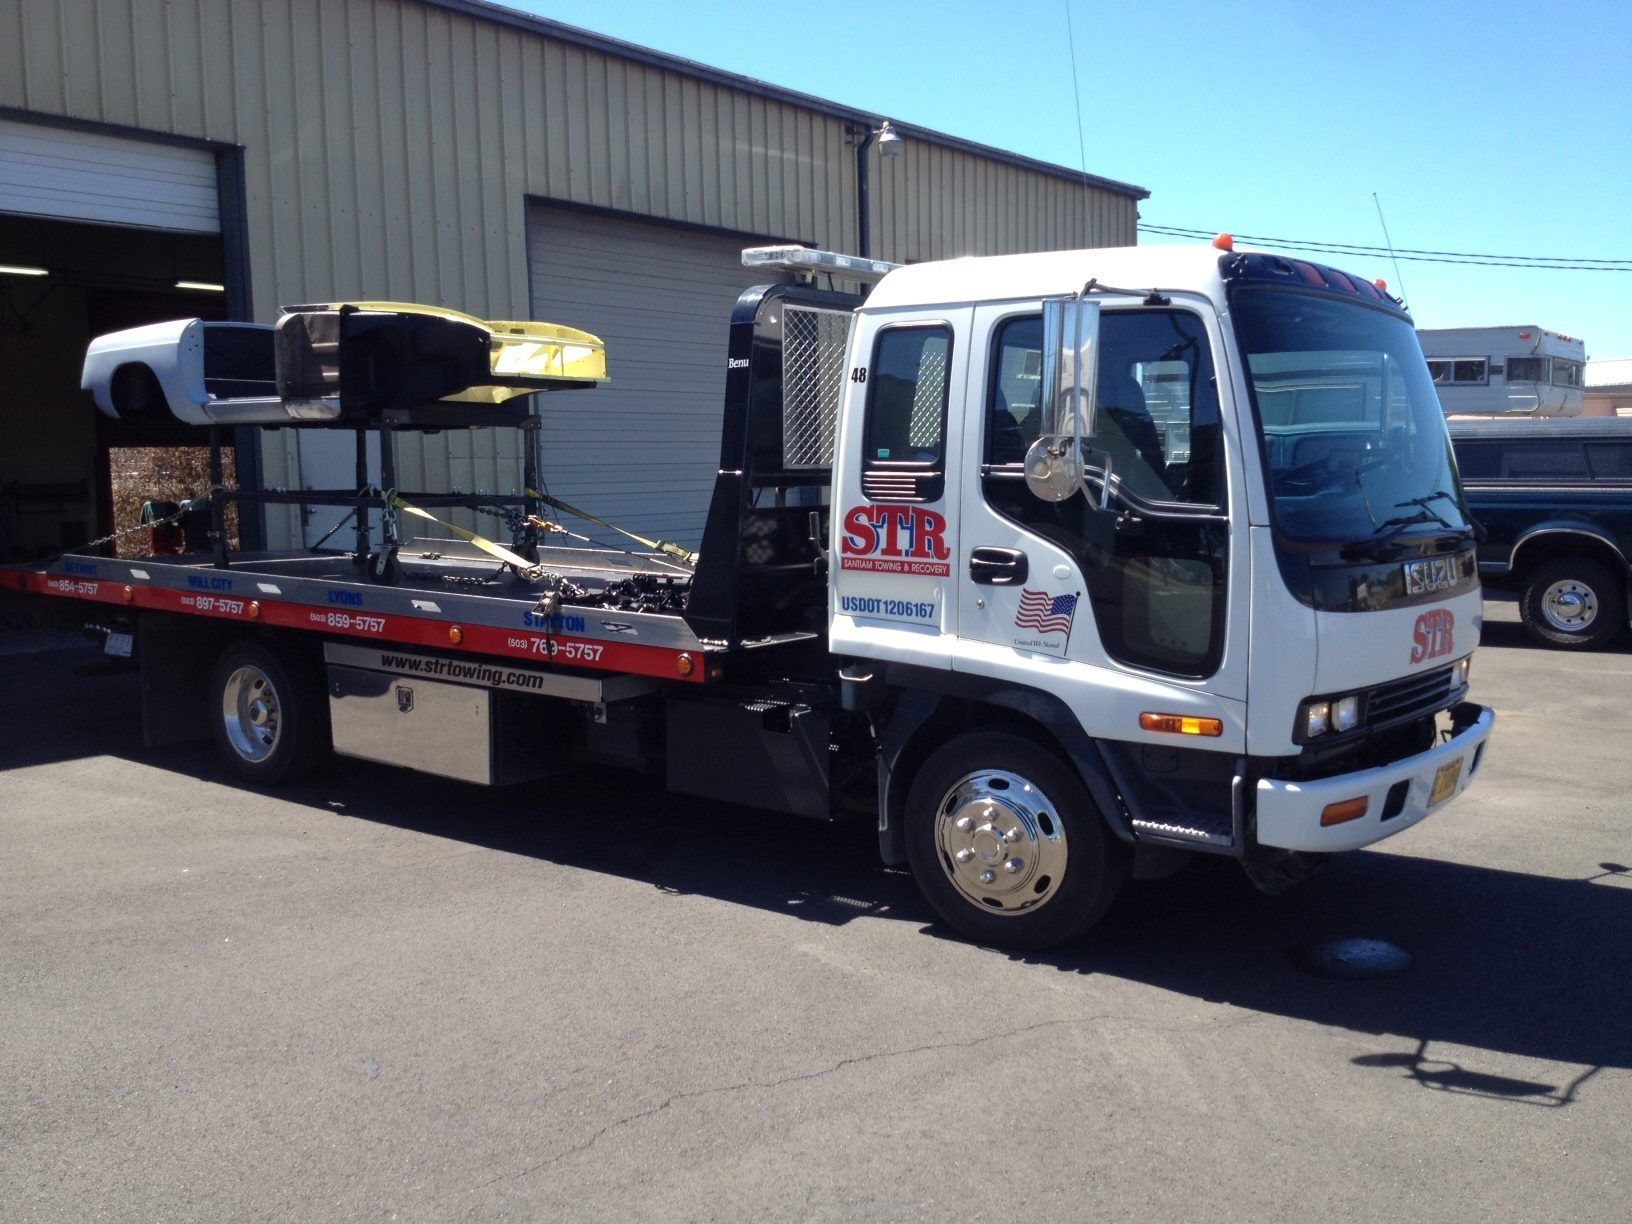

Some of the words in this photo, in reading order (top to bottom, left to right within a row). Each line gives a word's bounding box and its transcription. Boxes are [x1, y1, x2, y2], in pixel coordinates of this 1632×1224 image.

[728, 358, 750, 369] Benu
[851, 367, 867, 384] 48
[841, 504, 951, 561] STR
[843, 559, 874, 570] SANTIAM
[875, 561, 902, 572] TOWING
[903, 564, 910, 572] &
[911, 563, 948, 575] RECOVERY
[211, 577, 233, 591] CITY
[1404, 557, 1458, 595] ISUZU
[59, 579, 99, 595] 854-5757
[195, 596, 245, 615] 897-5757
[328, 590, 364, 606] LYONS
[309, 612, 326, 624] (503)
[326, 612, 386, 632] 859-5757
[507, 637, 528, 649] (503)
[1410, 608, 1455, 665] STR
[380, 653, 544, 690] www.strtowing.com
